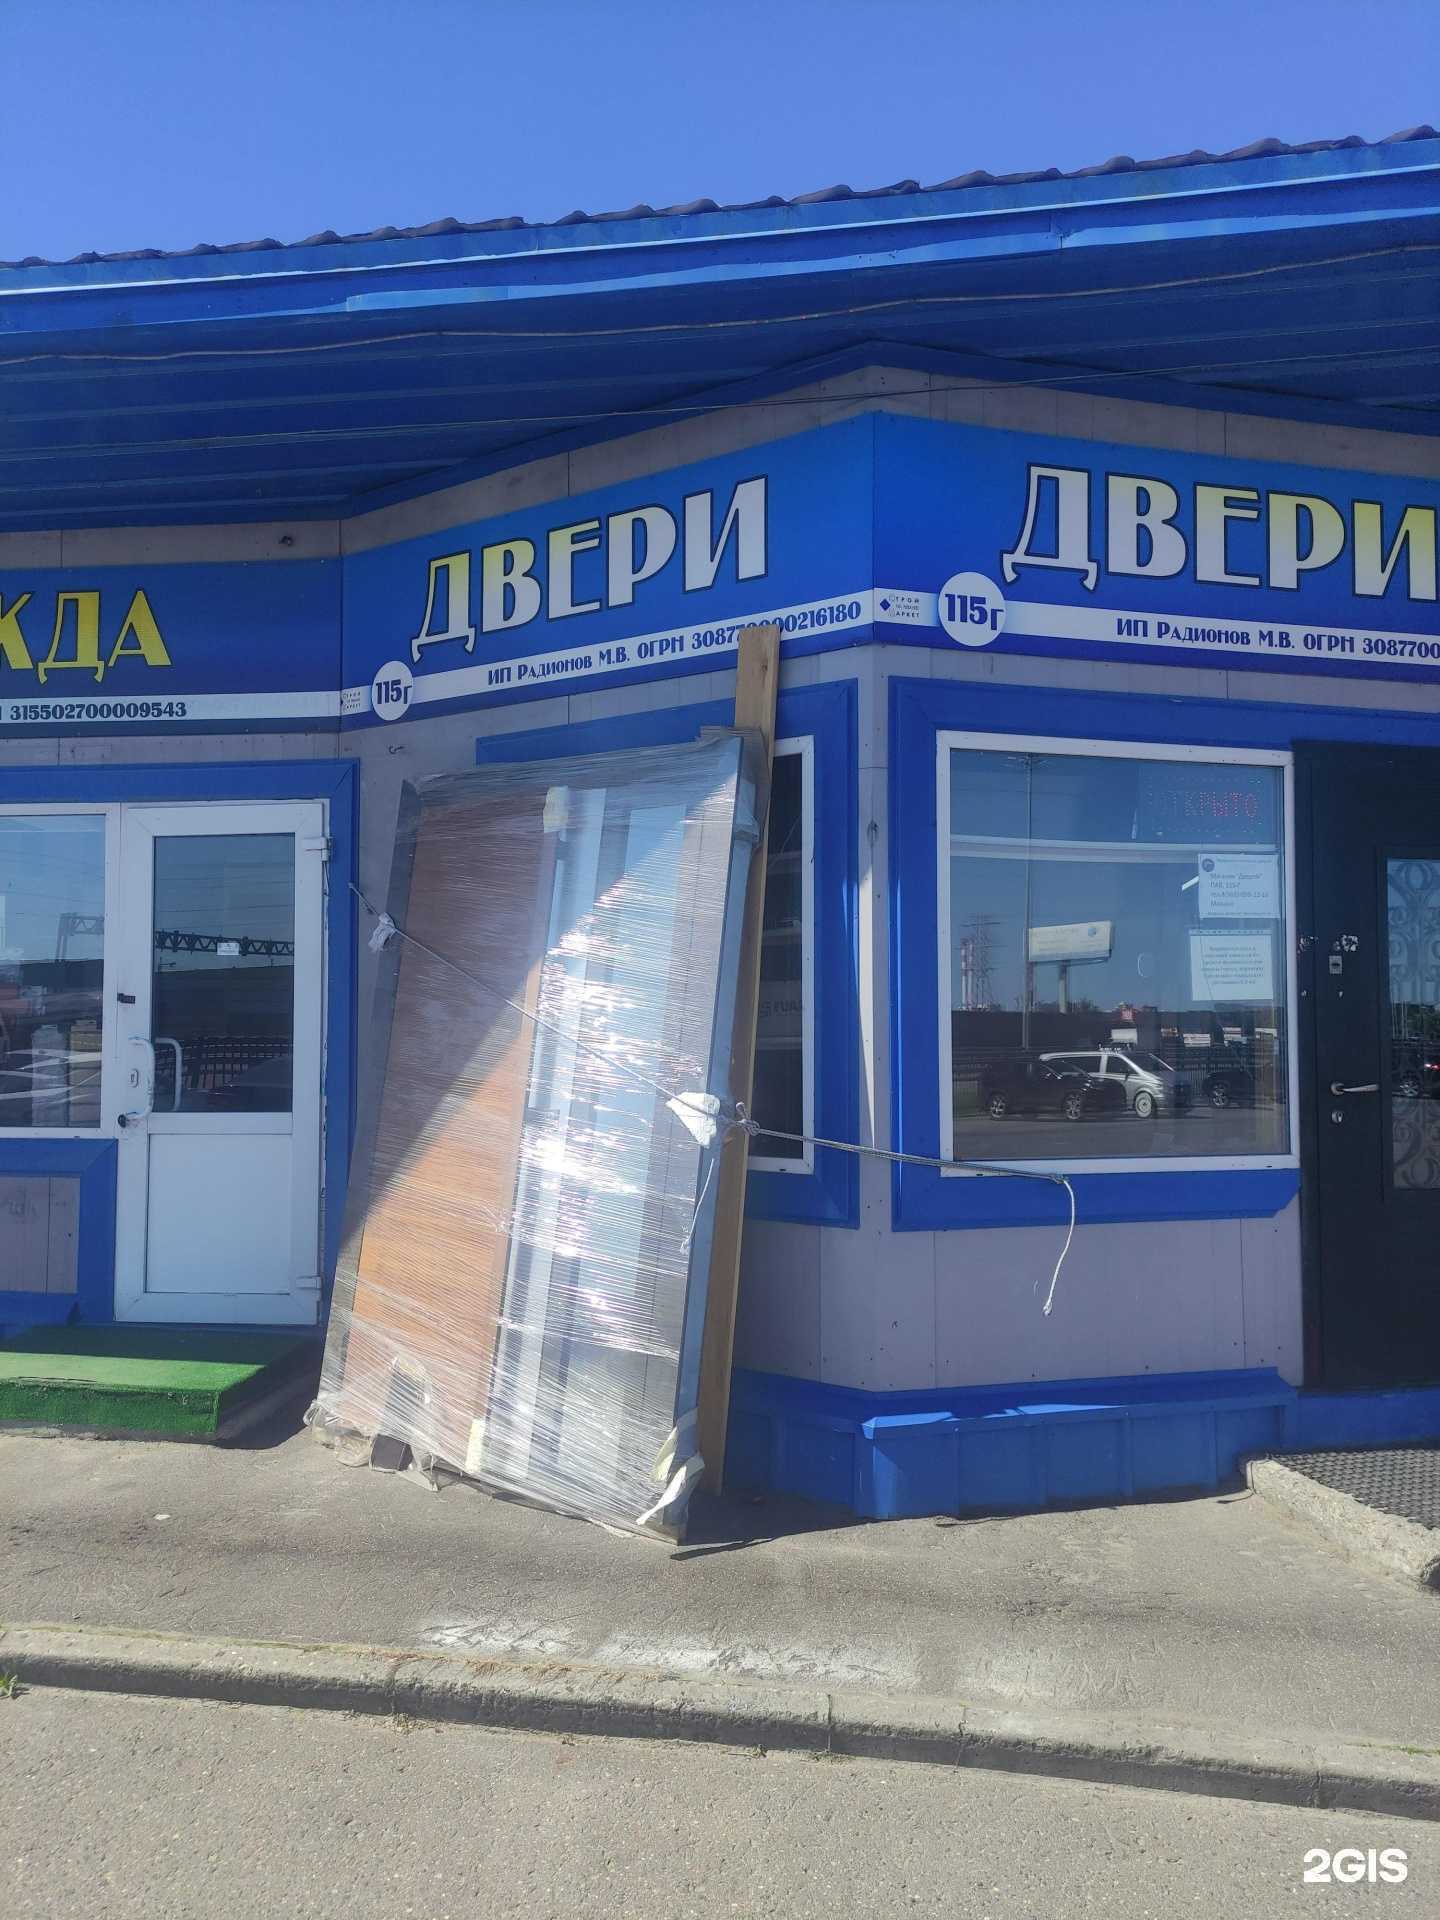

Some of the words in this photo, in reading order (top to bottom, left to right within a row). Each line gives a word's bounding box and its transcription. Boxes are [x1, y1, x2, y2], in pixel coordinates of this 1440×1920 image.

[411, 475, 769, 663] ДВЕРИ
[1002, 464, 1439, 601] ДВЕРИ
[488, 667, 512, 685] ИП
[599, 646, 630, 666] М.В.
[637, 635, 684, 659] ОГРН
[692, 601, 861, 650] 308700216180
[1117, 618, 1148, 637] ИП
[1259, 629, 1295, 648] М.В.
[1303, 633, 1355, 653] ОГРН
[1363, 638, 1440, 659] 3087700
[10, 702, 187, 720] 315502700009543
